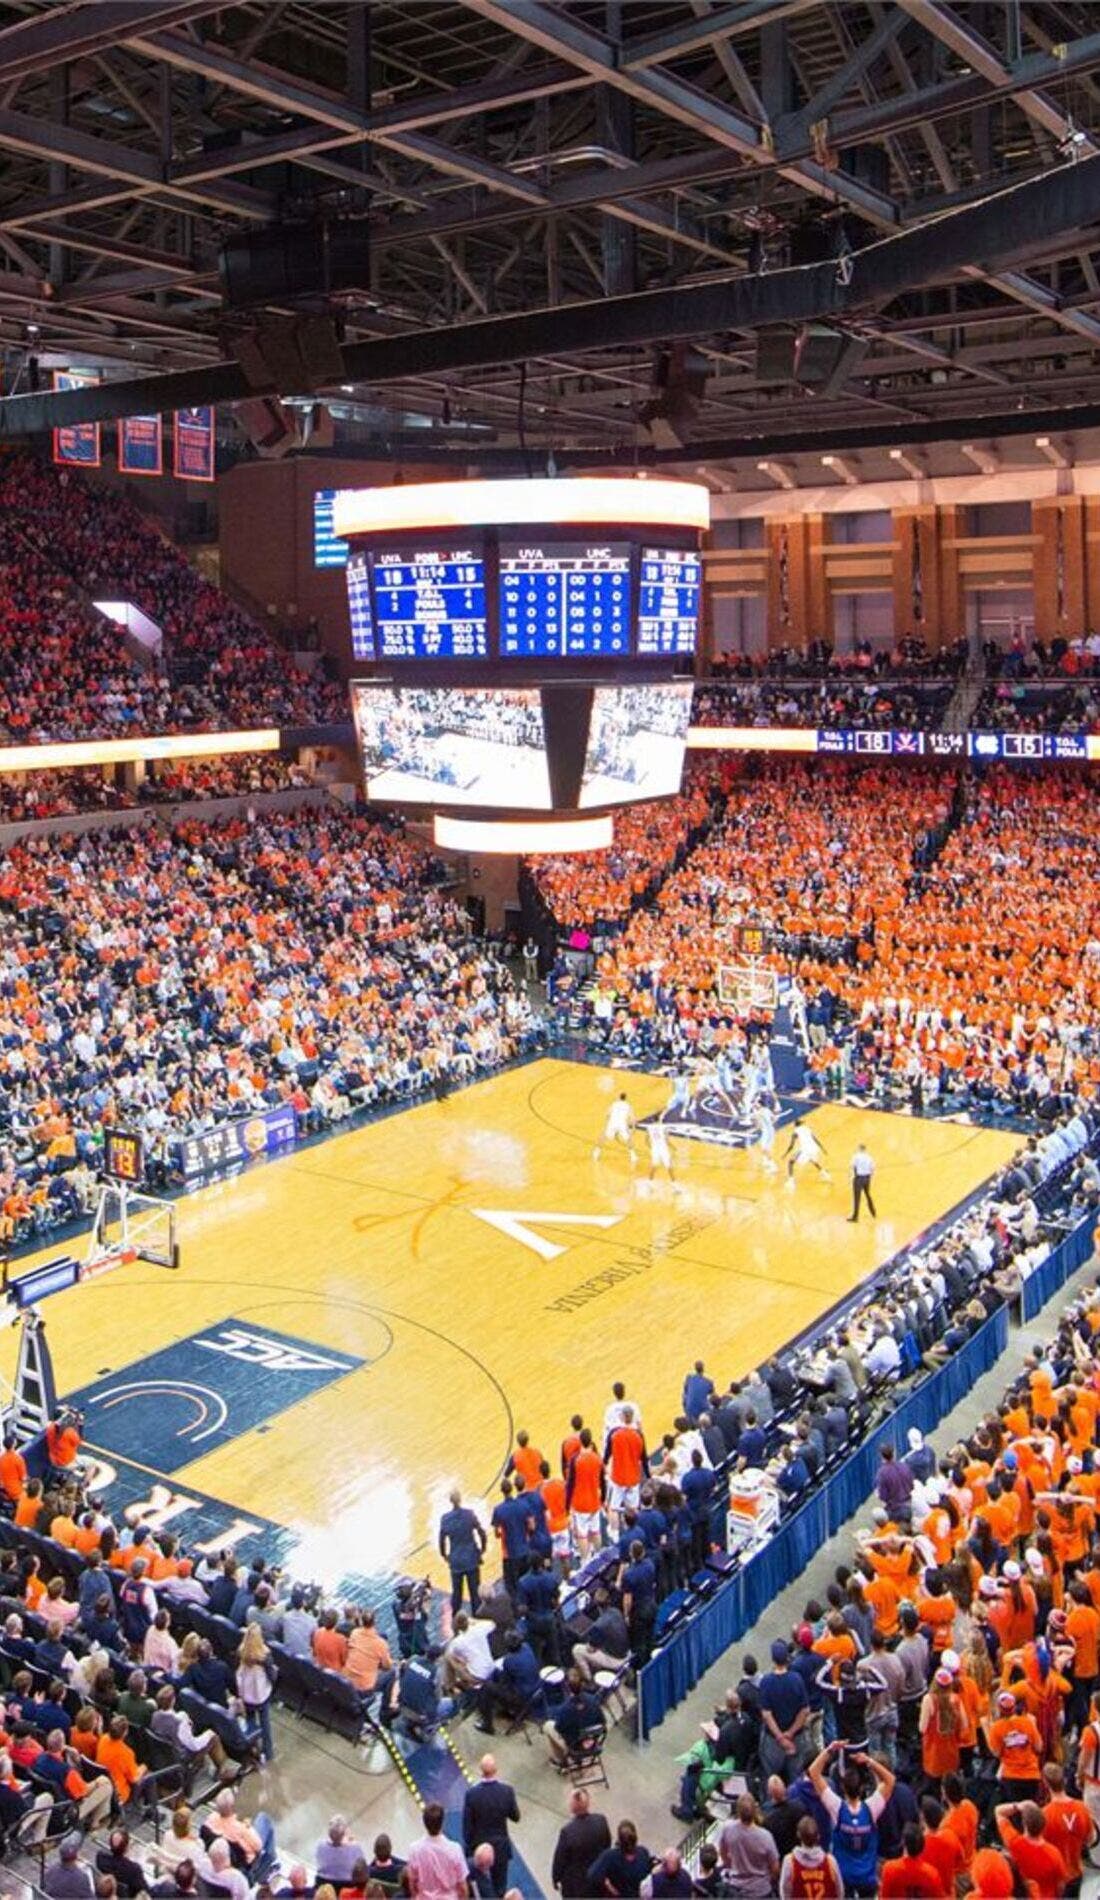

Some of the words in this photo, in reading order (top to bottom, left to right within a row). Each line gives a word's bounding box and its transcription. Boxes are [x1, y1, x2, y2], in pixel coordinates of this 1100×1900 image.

[381, 554, 401, 564] UVA
[451, 551, 472, 562] UNC
[519, 549, 544, 559] UVA
[587, 547, 611, 559] UNC
[384, 570, 402, 585] 18
[411, 566, 445, 578] 11:14
[457, 567, 475, 582] 15
[504, 575, 519, 586] 04
[547, 575, 556, 586] 0
[570, 574, 586, 585] 00
[593, 574, 601, 585] 0
[612, 574, 621, 585] 0
[506, 592, 518, 602] 10
[527, 592, 536, 602] 0
[547, 592, 556, 602] 0
[570, 591, 584, 601] 04
[612, 591, 621, 601] 0
[392, 602, 398, 612] 2
[508, 607, 516, 617] 11
[527, 607, 536, 618] 0
[547, 607, 556, 617] 0
[593, 606, 601, 617] 0
[613, 606, 620, 617] 3
[527, 623, 536, 634] 0
[571, 623, 584, 633] 42
[593, 622, 601, 633] 0
[612, 622, 621, 633] 0
[547, 639, 556, 650] 0
[570, 639, 584, 649] 44
[612, 638, 621, 649] 0
[864, 732, 884, 750] 18
[929, 733, 963, 747] 11:14
[1013, 736, 1035, 755] 15
[1056, 737, 1079, 747] T.O.L.
[193, 1329, 353, 1370] ACC
[1062, 1812, 1077, 1831] V
